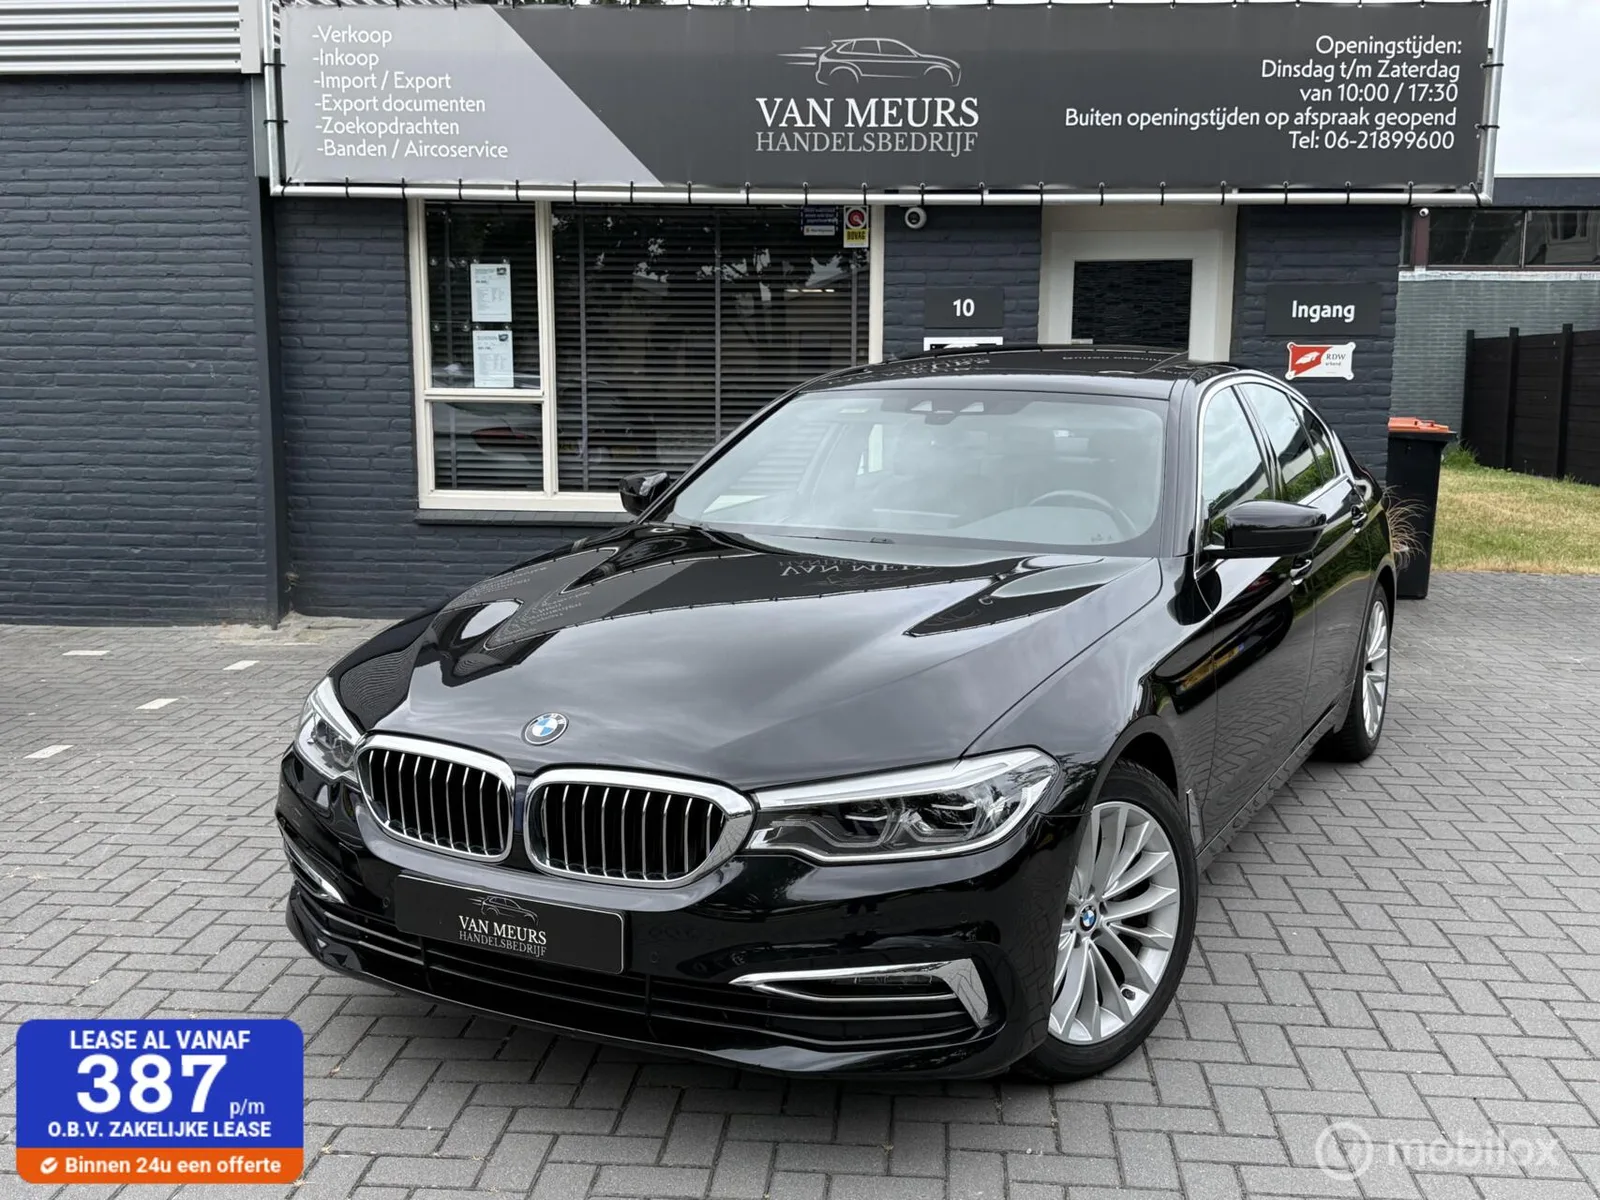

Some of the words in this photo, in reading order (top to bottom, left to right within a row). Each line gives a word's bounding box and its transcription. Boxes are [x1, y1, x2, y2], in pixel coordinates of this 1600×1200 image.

[312, 24, 392, 47] -Verkoop
[1316, 35, 1461, 58] Openingstijden:
[313, 48, 379, 70] -Inkoop
[1262, 59, 1333, 82] Dinsdag
[1340, 59, 1371, 79] t/m
[1378, 58, 1460, 82] Zaterdag
[314, 72, 377, 93] -Import
[381, 70, 389, 90] /
[394, 71, 451, 93] Export
[1300, 89, 1331, 101] van
[1338, 84, 1389, 101] 10:00
[1394, 83, 1404, 103] /
[1409, 84, 1458, 101] 17:30
[315, 94, 379, 116] -Export
[383, 94, 485, 112] documenten
[756, 98, 834, 127] VAN
[845, 98, 978, 127] MEURS
[316, 116, 459, 138] -Zoekopdrachten
[1066, 108, 1122, 126] Buiten
[1127, 107, 1259, 130] openingstijden
[1265, 112, 1289, 129] op
[1294, 106, 1369, 129] afspraak
[1375, 107, 1456, 130] geopend
[317, 139, 386, 156] -Banden
[392, 139, 399, 158] /
[405, 140, 508, 158] Aircoservice
[756, 132, 978, 157] HANDELSBEDRIJF
[1289, 130, 1319, 148] Tel:
[1325, 129, 1454, 149] 06-21899600
[954, 299, 974, 316] 10
[1292, 301, 1355, 322] Ingang
[1326, 353, 1346, 361] RDW
[458, 916, 489, 935] VAN
[493, 922, 547, 945] MEURS
[458, 930, 547, 957] HANDELSBEDRIJF
